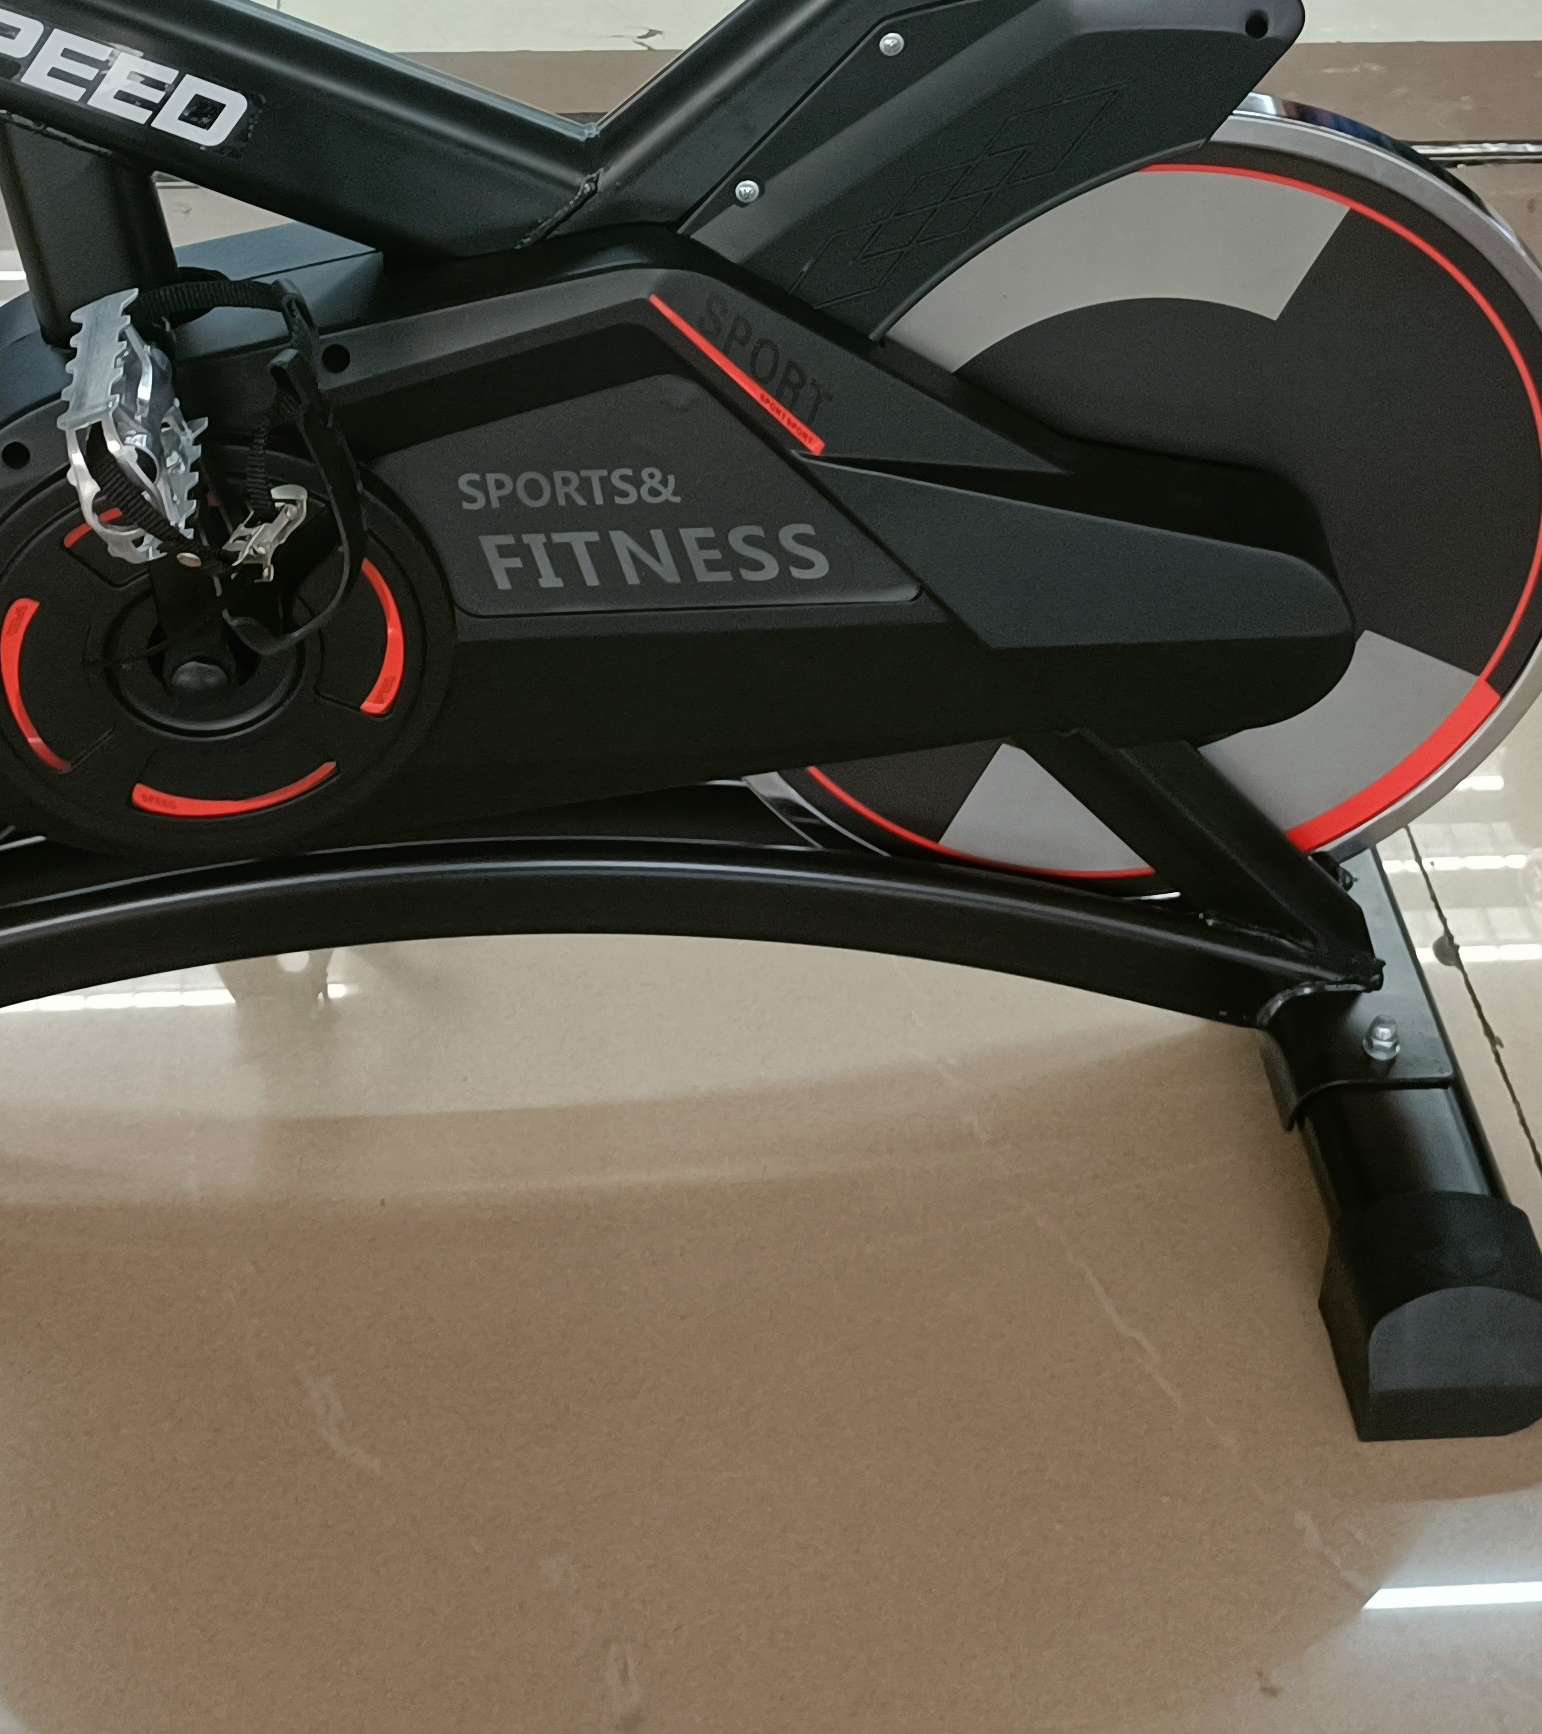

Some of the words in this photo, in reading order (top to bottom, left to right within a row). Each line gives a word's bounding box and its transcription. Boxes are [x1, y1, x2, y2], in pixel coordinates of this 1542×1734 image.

[698, 295, 833, 424] SPORT
[457, 467, 681, 511] SPORTS&
[477, 522, 830, 592] FITNESS
